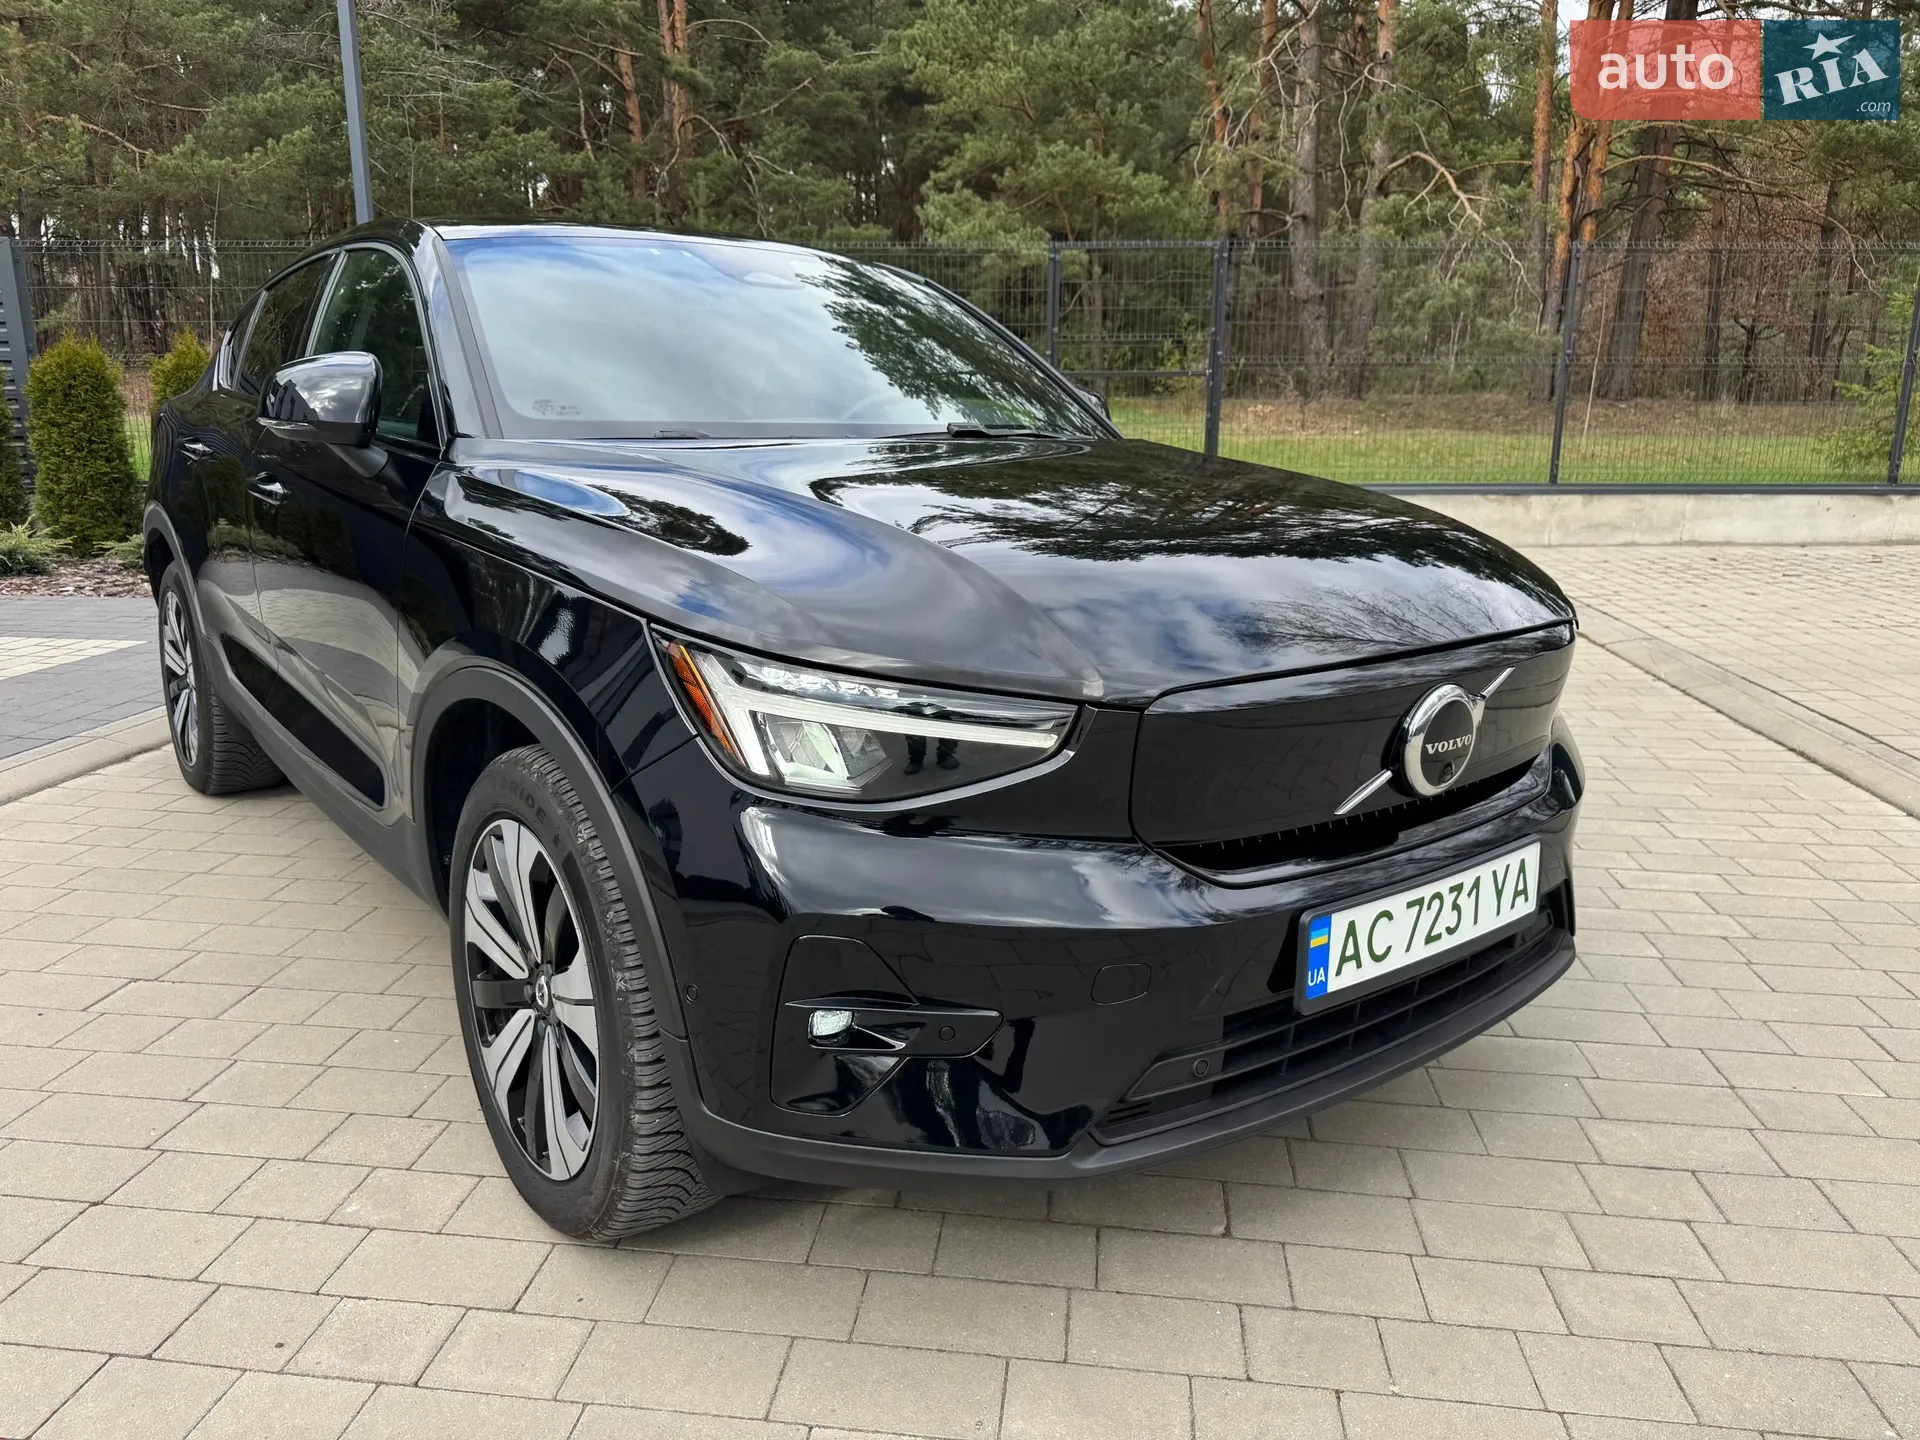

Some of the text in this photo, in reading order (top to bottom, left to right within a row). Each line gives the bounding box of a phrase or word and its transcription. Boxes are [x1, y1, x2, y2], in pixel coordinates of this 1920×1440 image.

[1425, 734, 1472, 755] VOLVO
[1334, 857, 1529, 977] AC 7231 YA
[1307, 969, 1326, 987] UA
